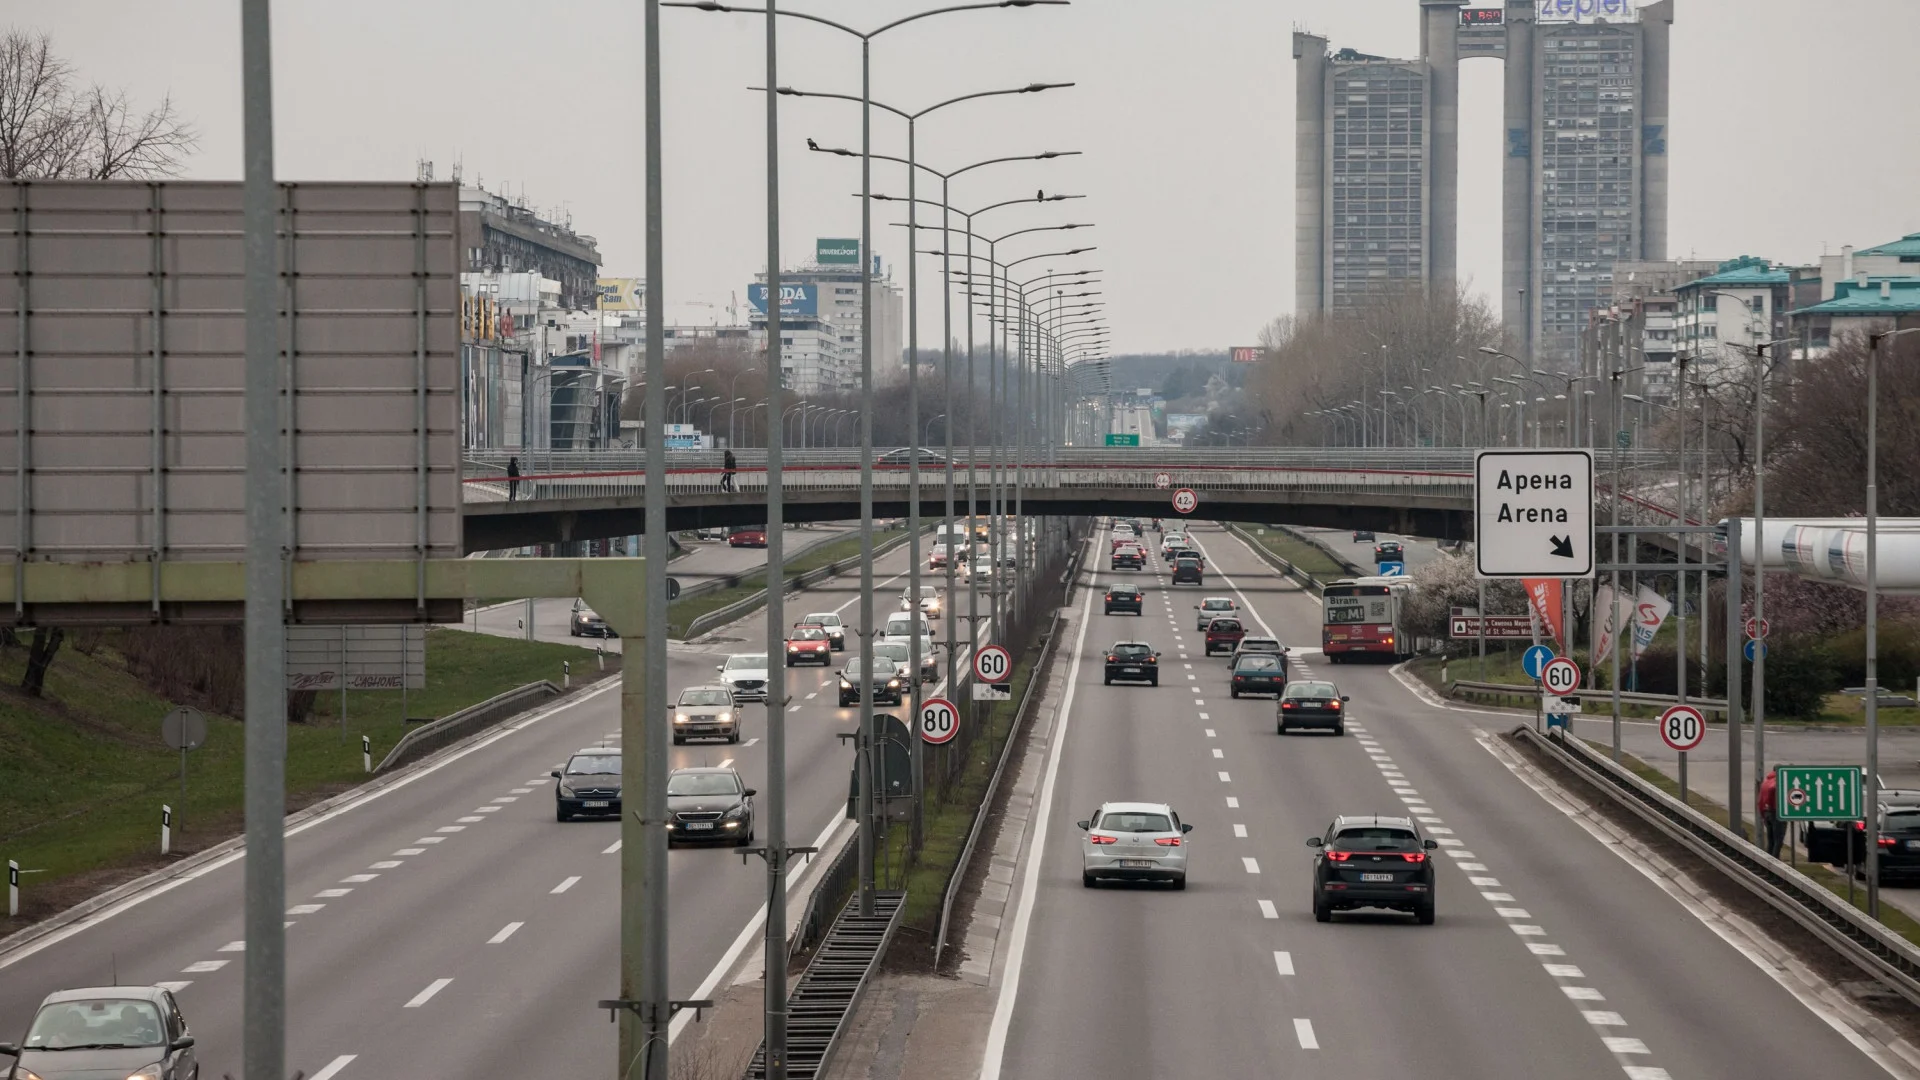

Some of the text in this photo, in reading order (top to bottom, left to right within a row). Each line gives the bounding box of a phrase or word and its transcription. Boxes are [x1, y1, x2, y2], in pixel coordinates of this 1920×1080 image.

[603, 294, 622, 303] Sam
[1497, 469, 1572, 495] Арена
[1497, 503, 1568, 523] Arena
[1329, 596, 1359, 605] Biram
[981, 654, 1004, 674] 60
[1550, 667, 1572, 686] 60
[924, 708, 951, 732] 80
[1669, 717, 1696, 740] 80
